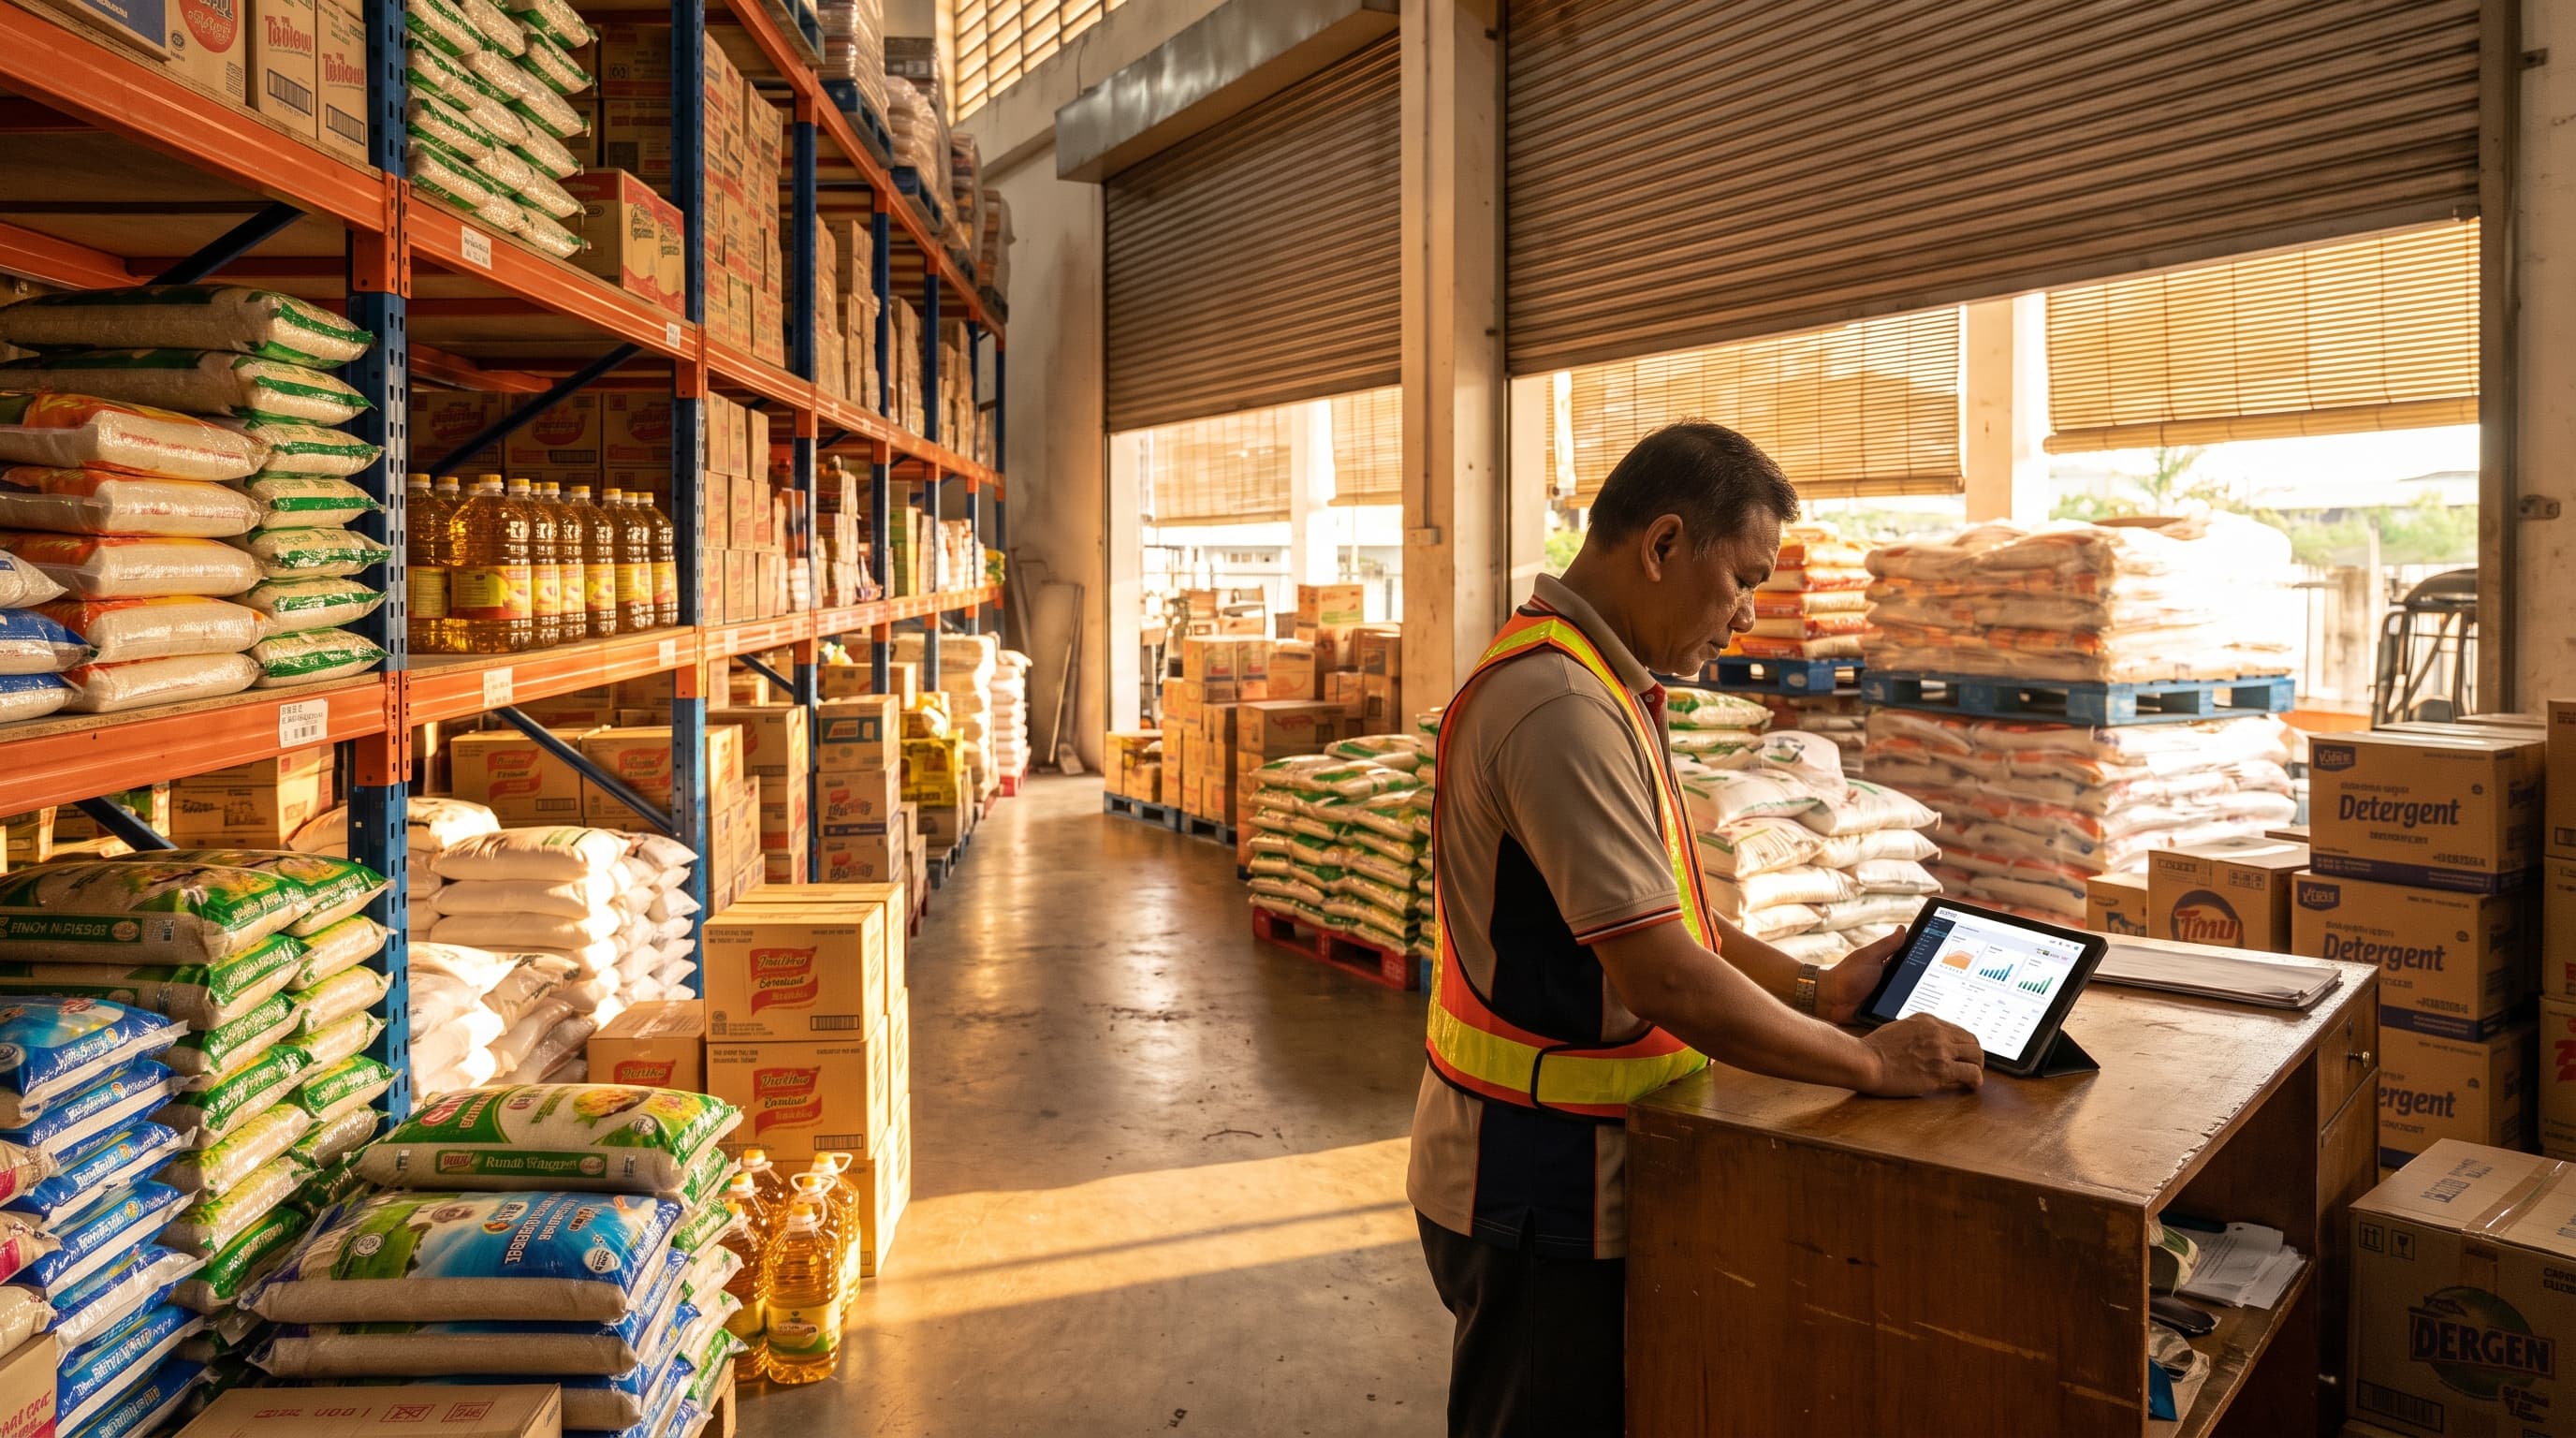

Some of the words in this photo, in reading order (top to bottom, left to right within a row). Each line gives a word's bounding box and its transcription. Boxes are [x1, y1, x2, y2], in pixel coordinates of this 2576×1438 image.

[2338, 794, 2462, 829] Detergent
[2322, 932, 2446, 972] Detergent
[2378, 1086, 2457, 1119] ergent
[2413, 1315, 2552, 1373] DERGEN
